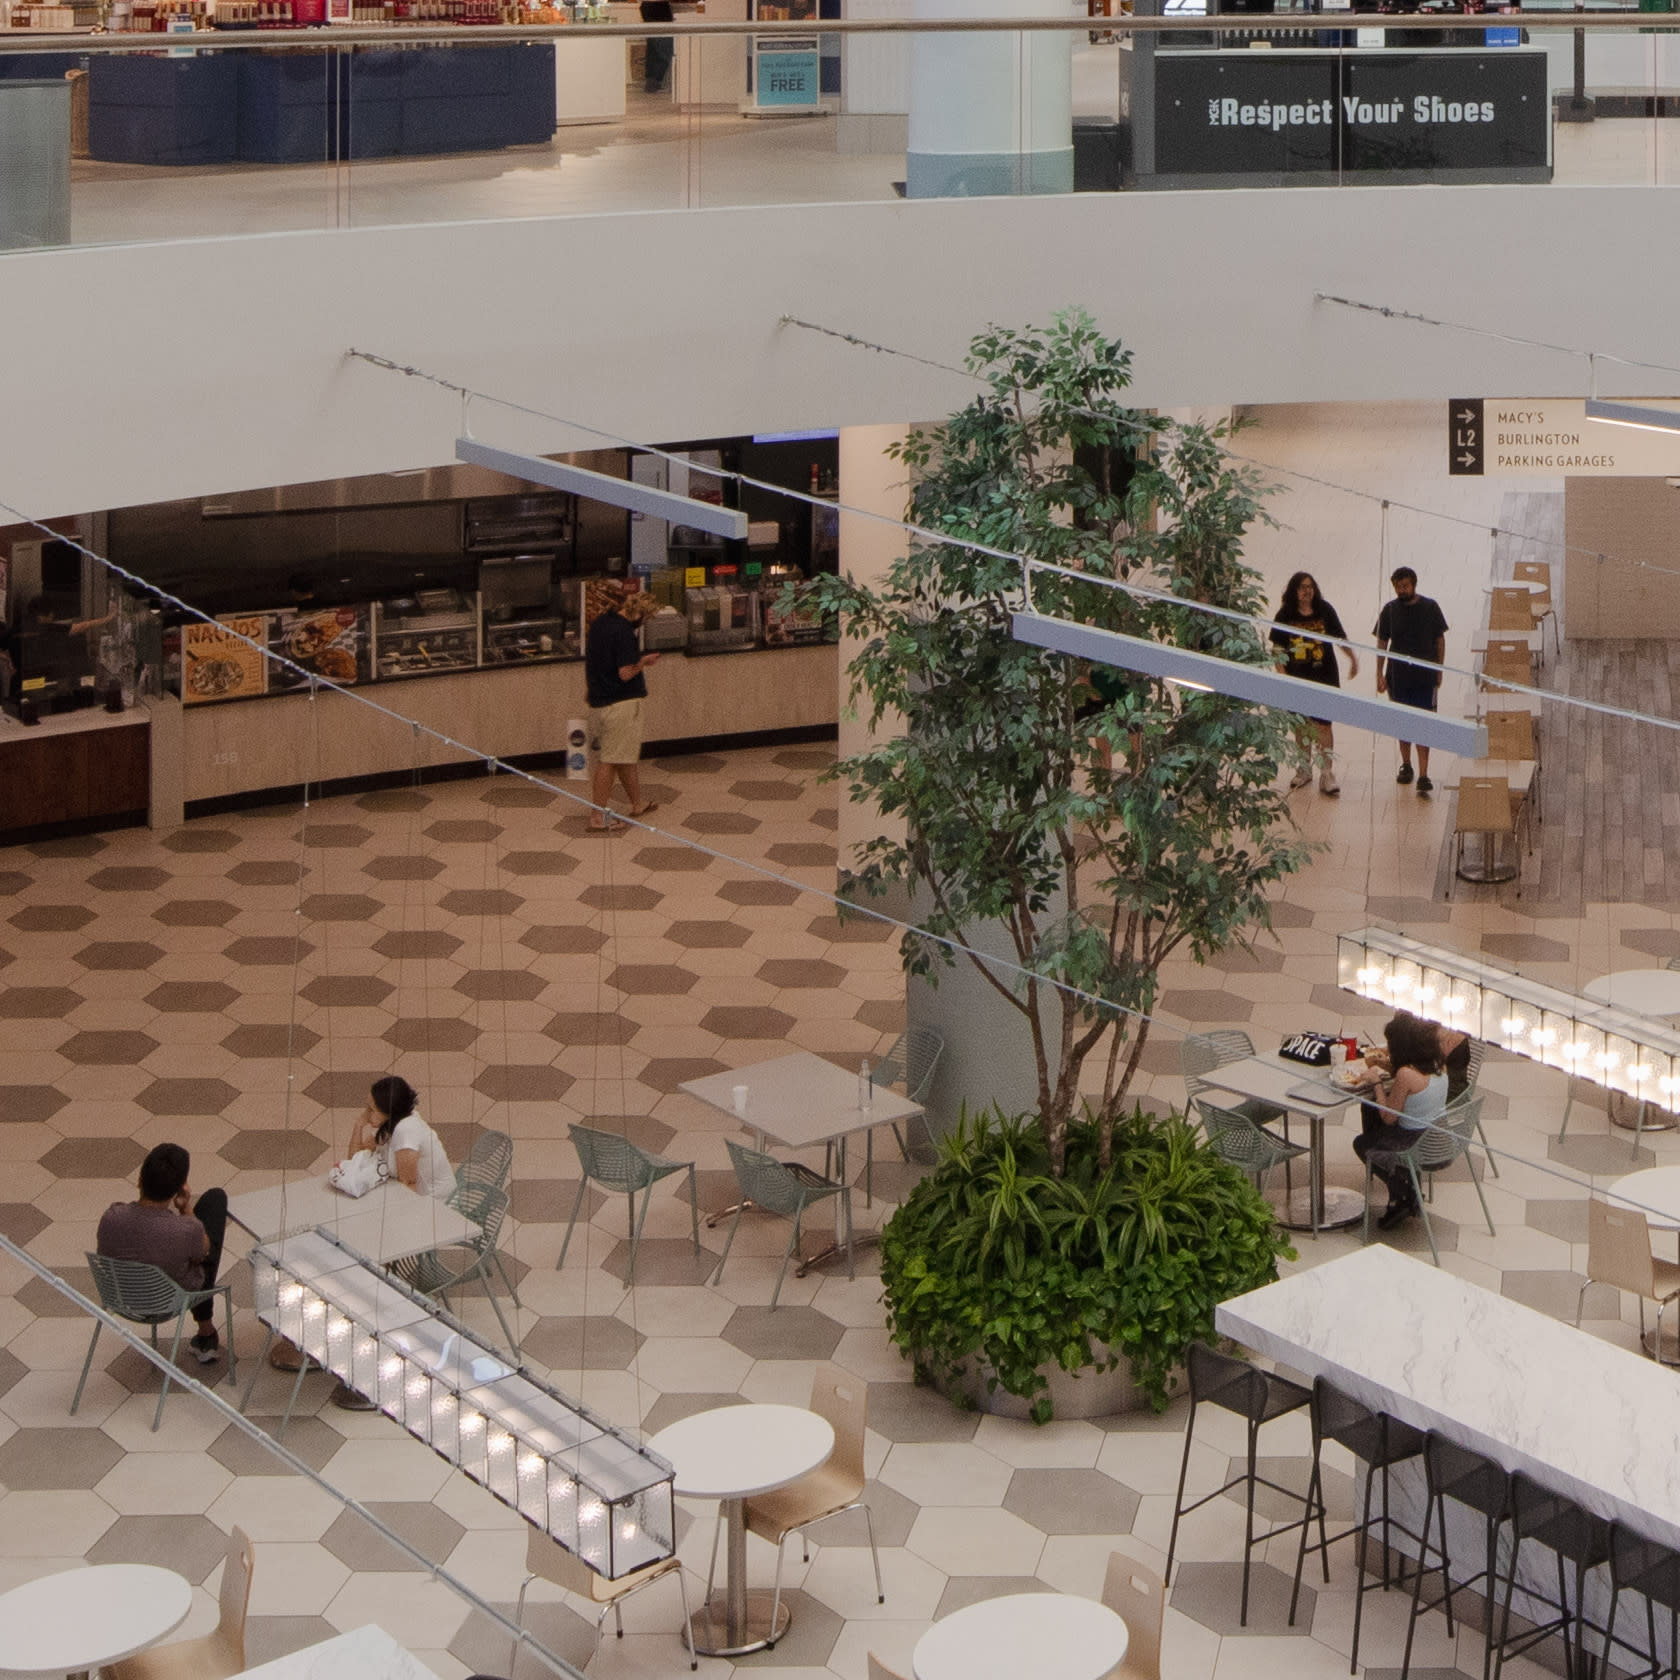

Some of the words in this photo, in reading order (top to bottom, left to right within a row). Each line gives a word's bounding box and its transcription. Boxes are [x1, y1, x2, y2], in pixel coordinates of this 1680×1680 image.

[770, 78, 805, 92] FREE
[1222, 98, 1333, 131] Respect
[1343, 97, 1404, 125] Your
[1414, 95, 1495, 124] Shoes
[1497, 411, 1545, 424] MACY'S
[1457, 429, 1476, 447] L2
[1497, 433, 1581, 446] BURLINGTON
[1497, 455, 1554, 468] PARKING
[1556, 455, 1616, 468] GARAGES
